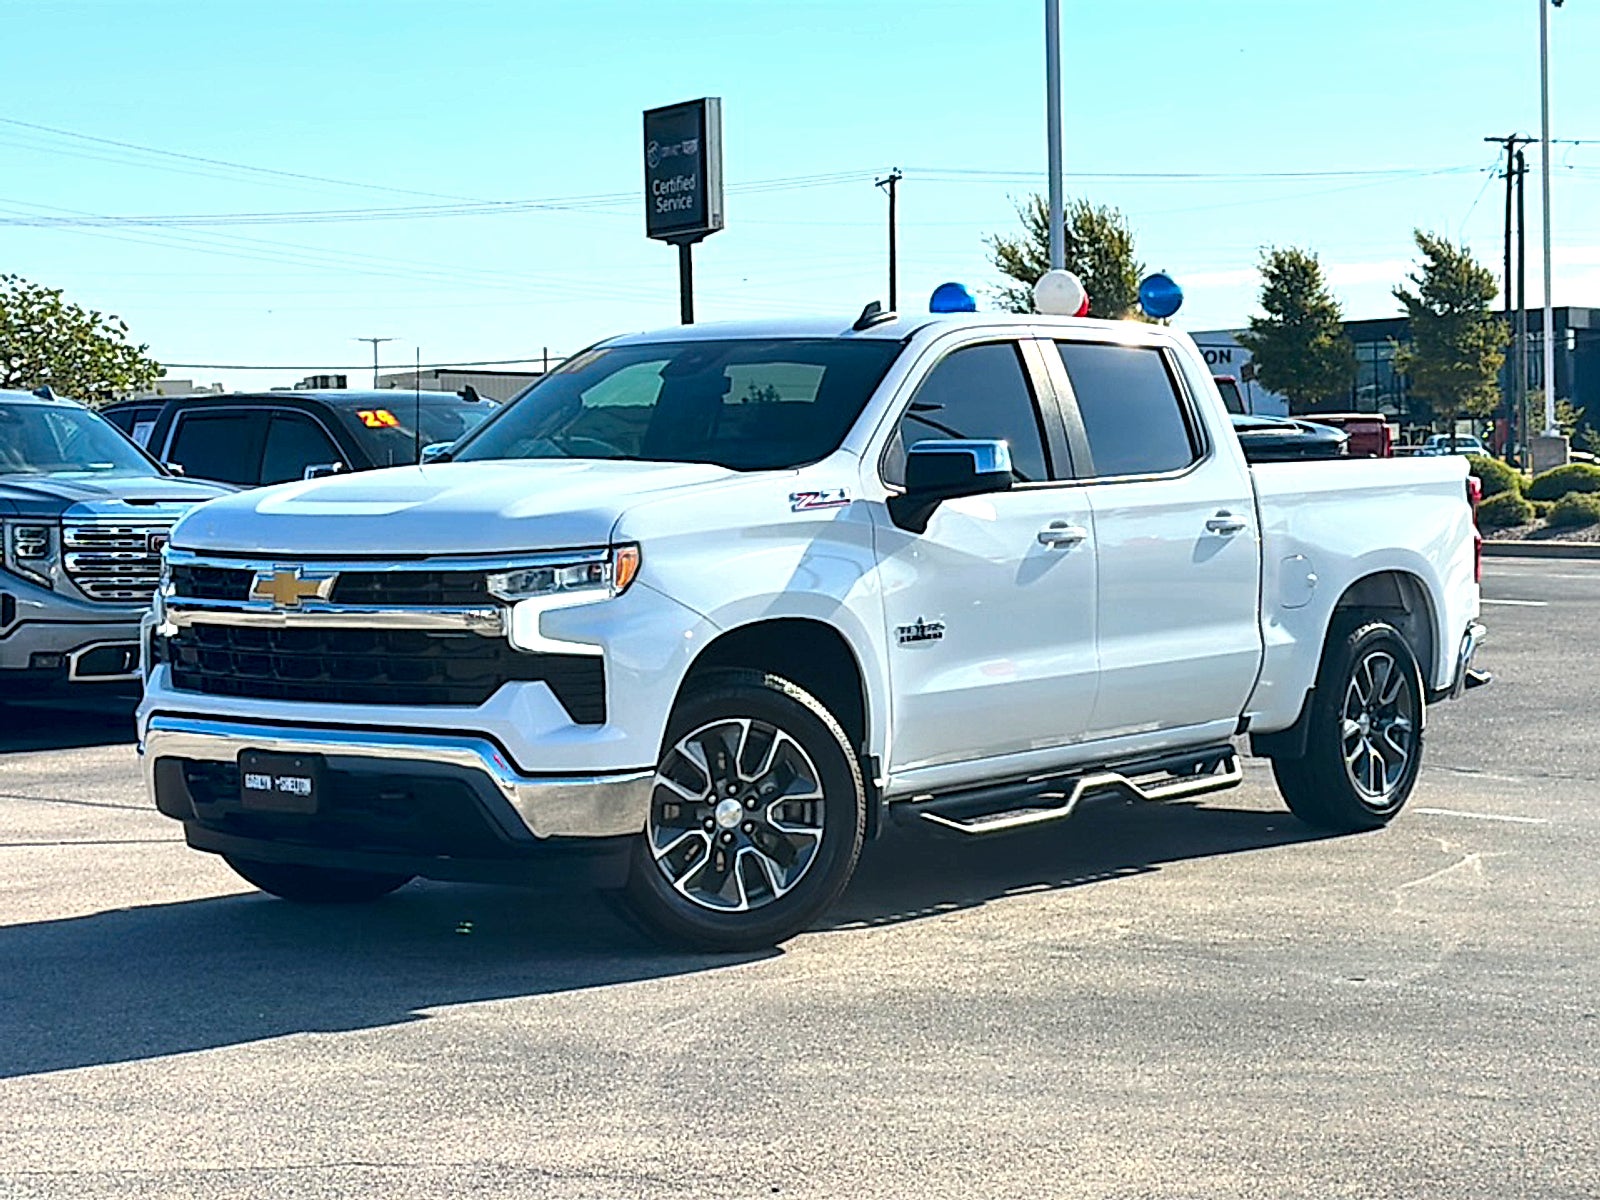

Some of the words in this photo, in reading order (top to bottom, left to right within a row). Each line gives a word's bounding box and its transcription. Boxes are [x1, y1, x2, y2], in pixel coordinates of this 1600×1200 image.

[652, 174, 697, 196] Certified
[656, 193, 693, 213] Service
[1200, 348, 1231, 364] ON
